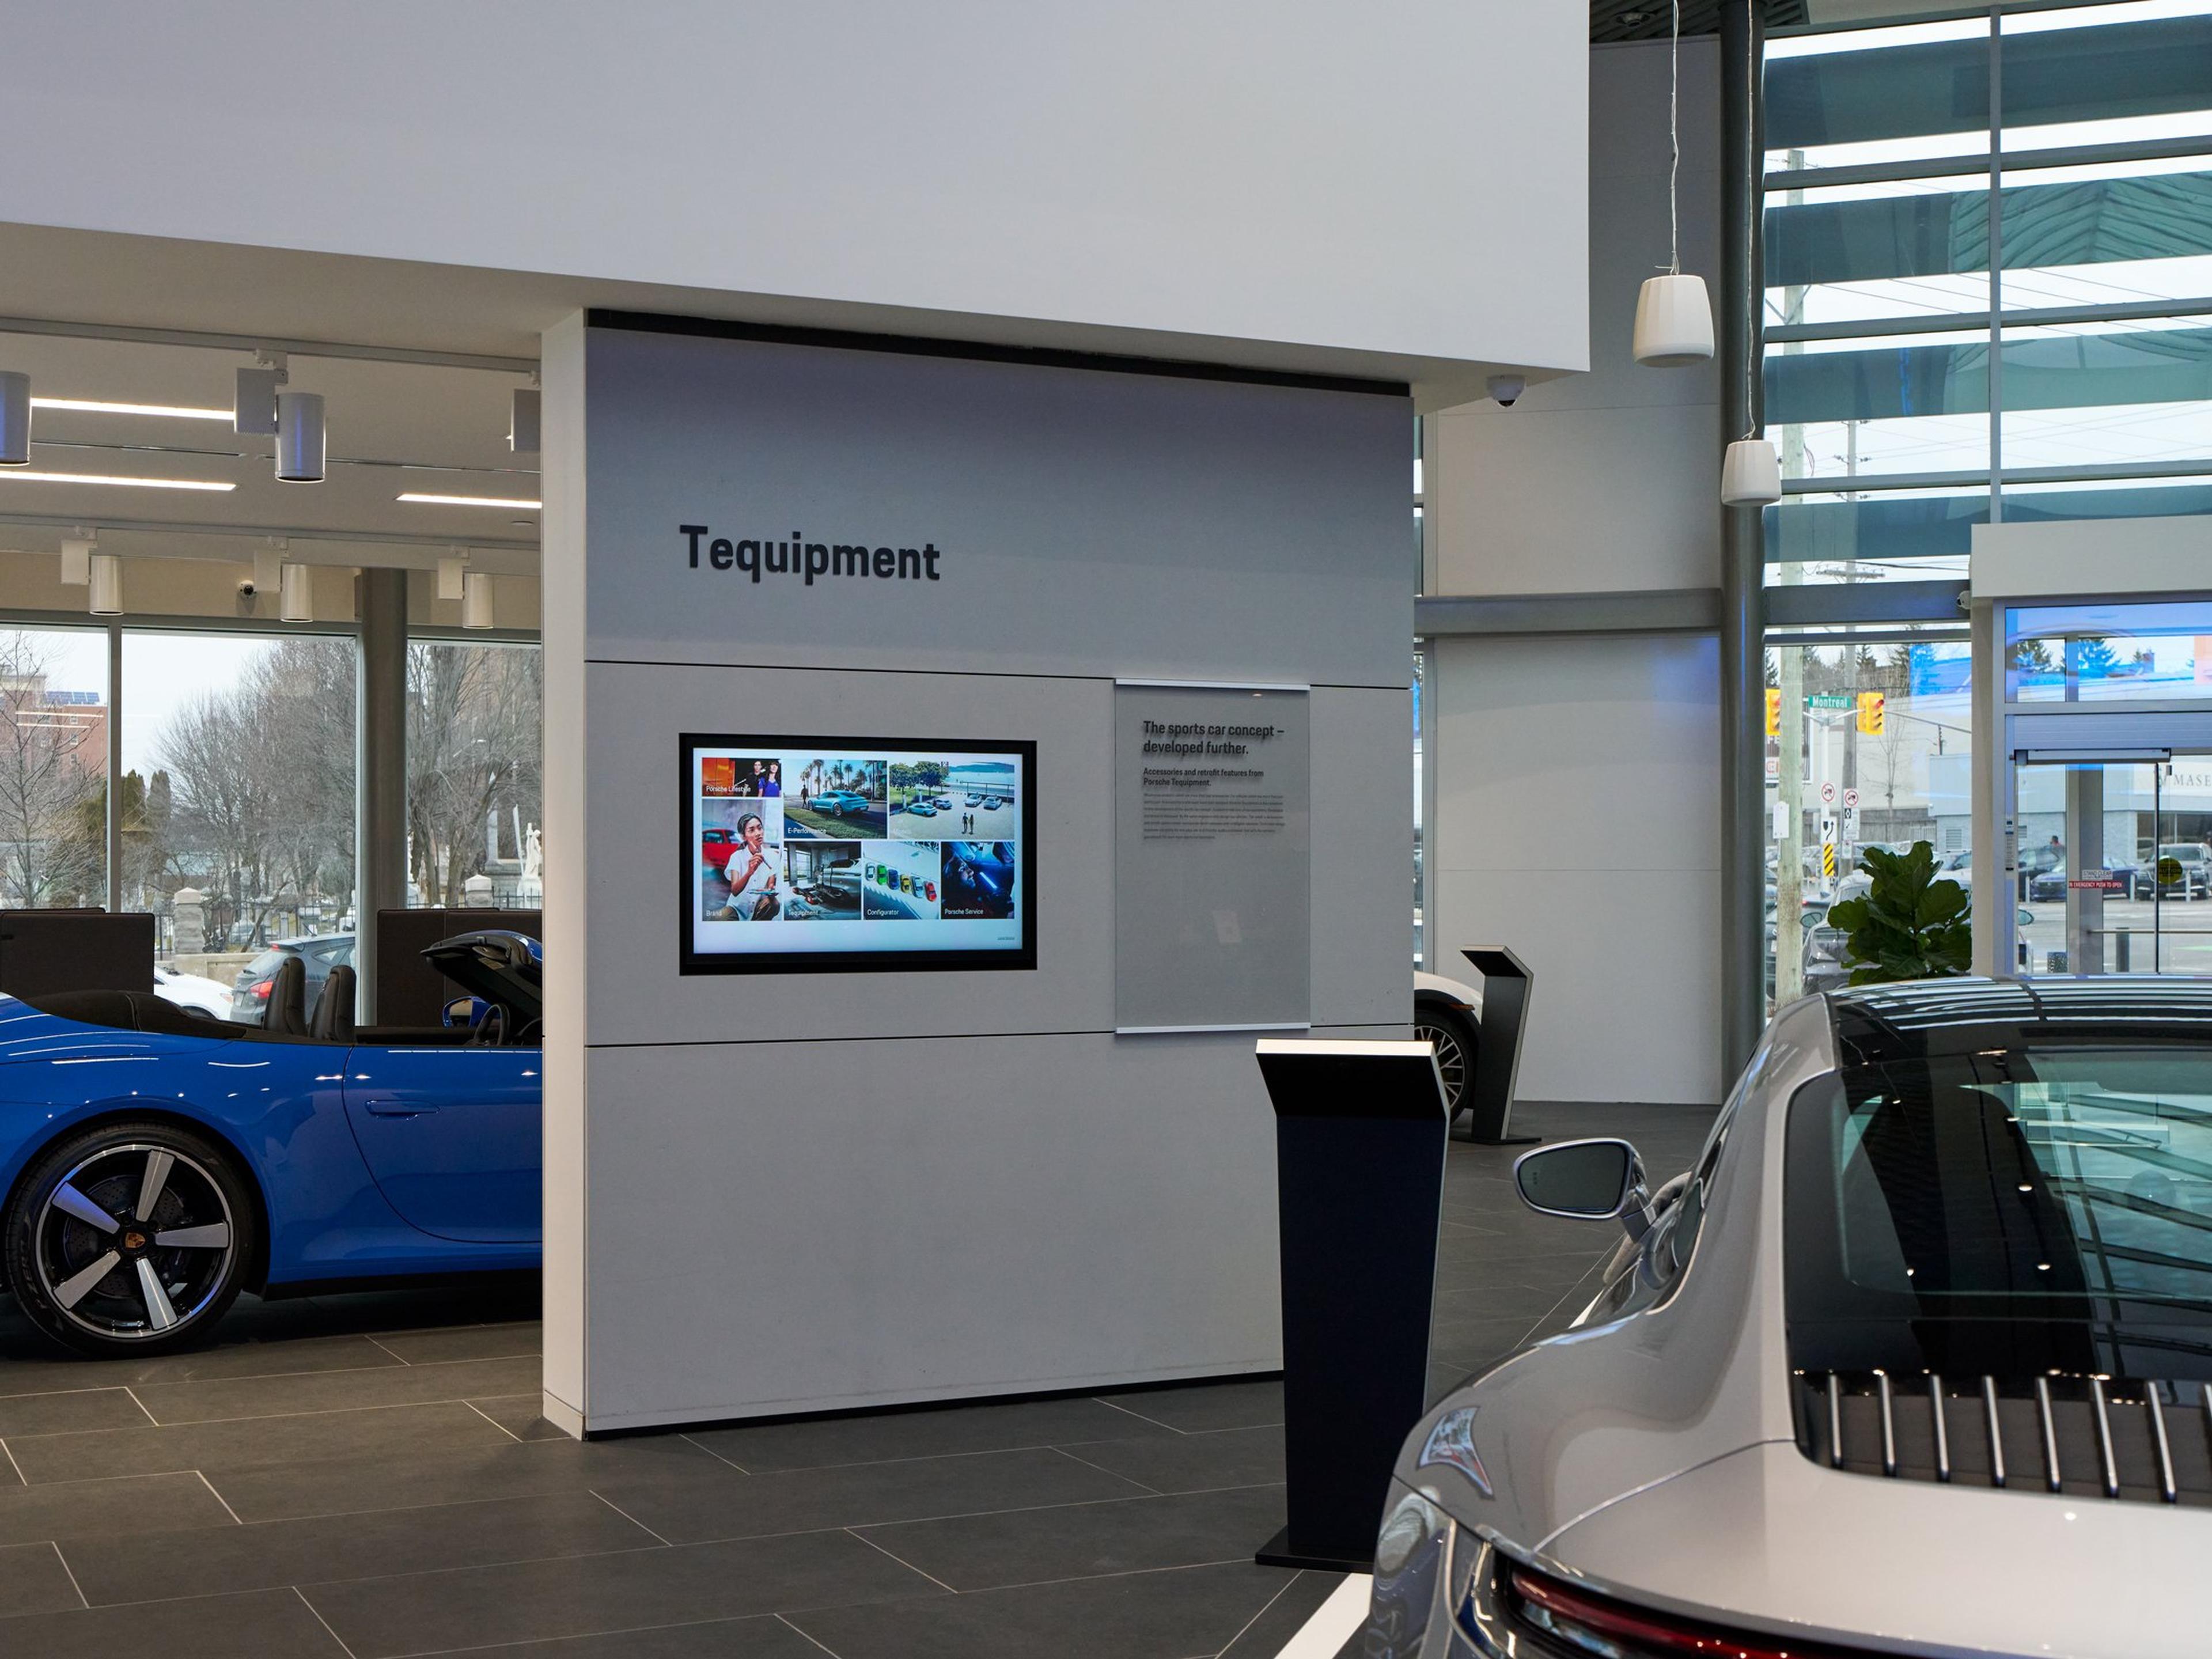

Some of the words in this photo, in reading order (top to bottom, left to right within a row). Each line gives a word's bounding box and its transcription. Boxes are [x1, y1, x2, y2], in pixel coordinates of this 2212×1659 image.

[680, 525, 940, 586] Tequipment
[1813, 696, 1847, 708] Montreal
[1143, 721, 1165, 734] The
[1168, 723, 1205, 737] sports
[1208, 725, 1226, 736] car
[1229, 725, 1274, 740] concept
[1143, 740, 1203, 756] developed
[1207, 741, 1249, 755] further.
[1143, 767, 1183, 776] Accessories
[1197, 768, 1219, 777] retrofit
[1221, 769, 1247, 777] features
[1248, 769, 1264, 777] from
[1143, 778, 1170, 786] Porsche
[1171, 778, 1212, 787] Tequipment.
[867, 908, 899, 916] Configurator
